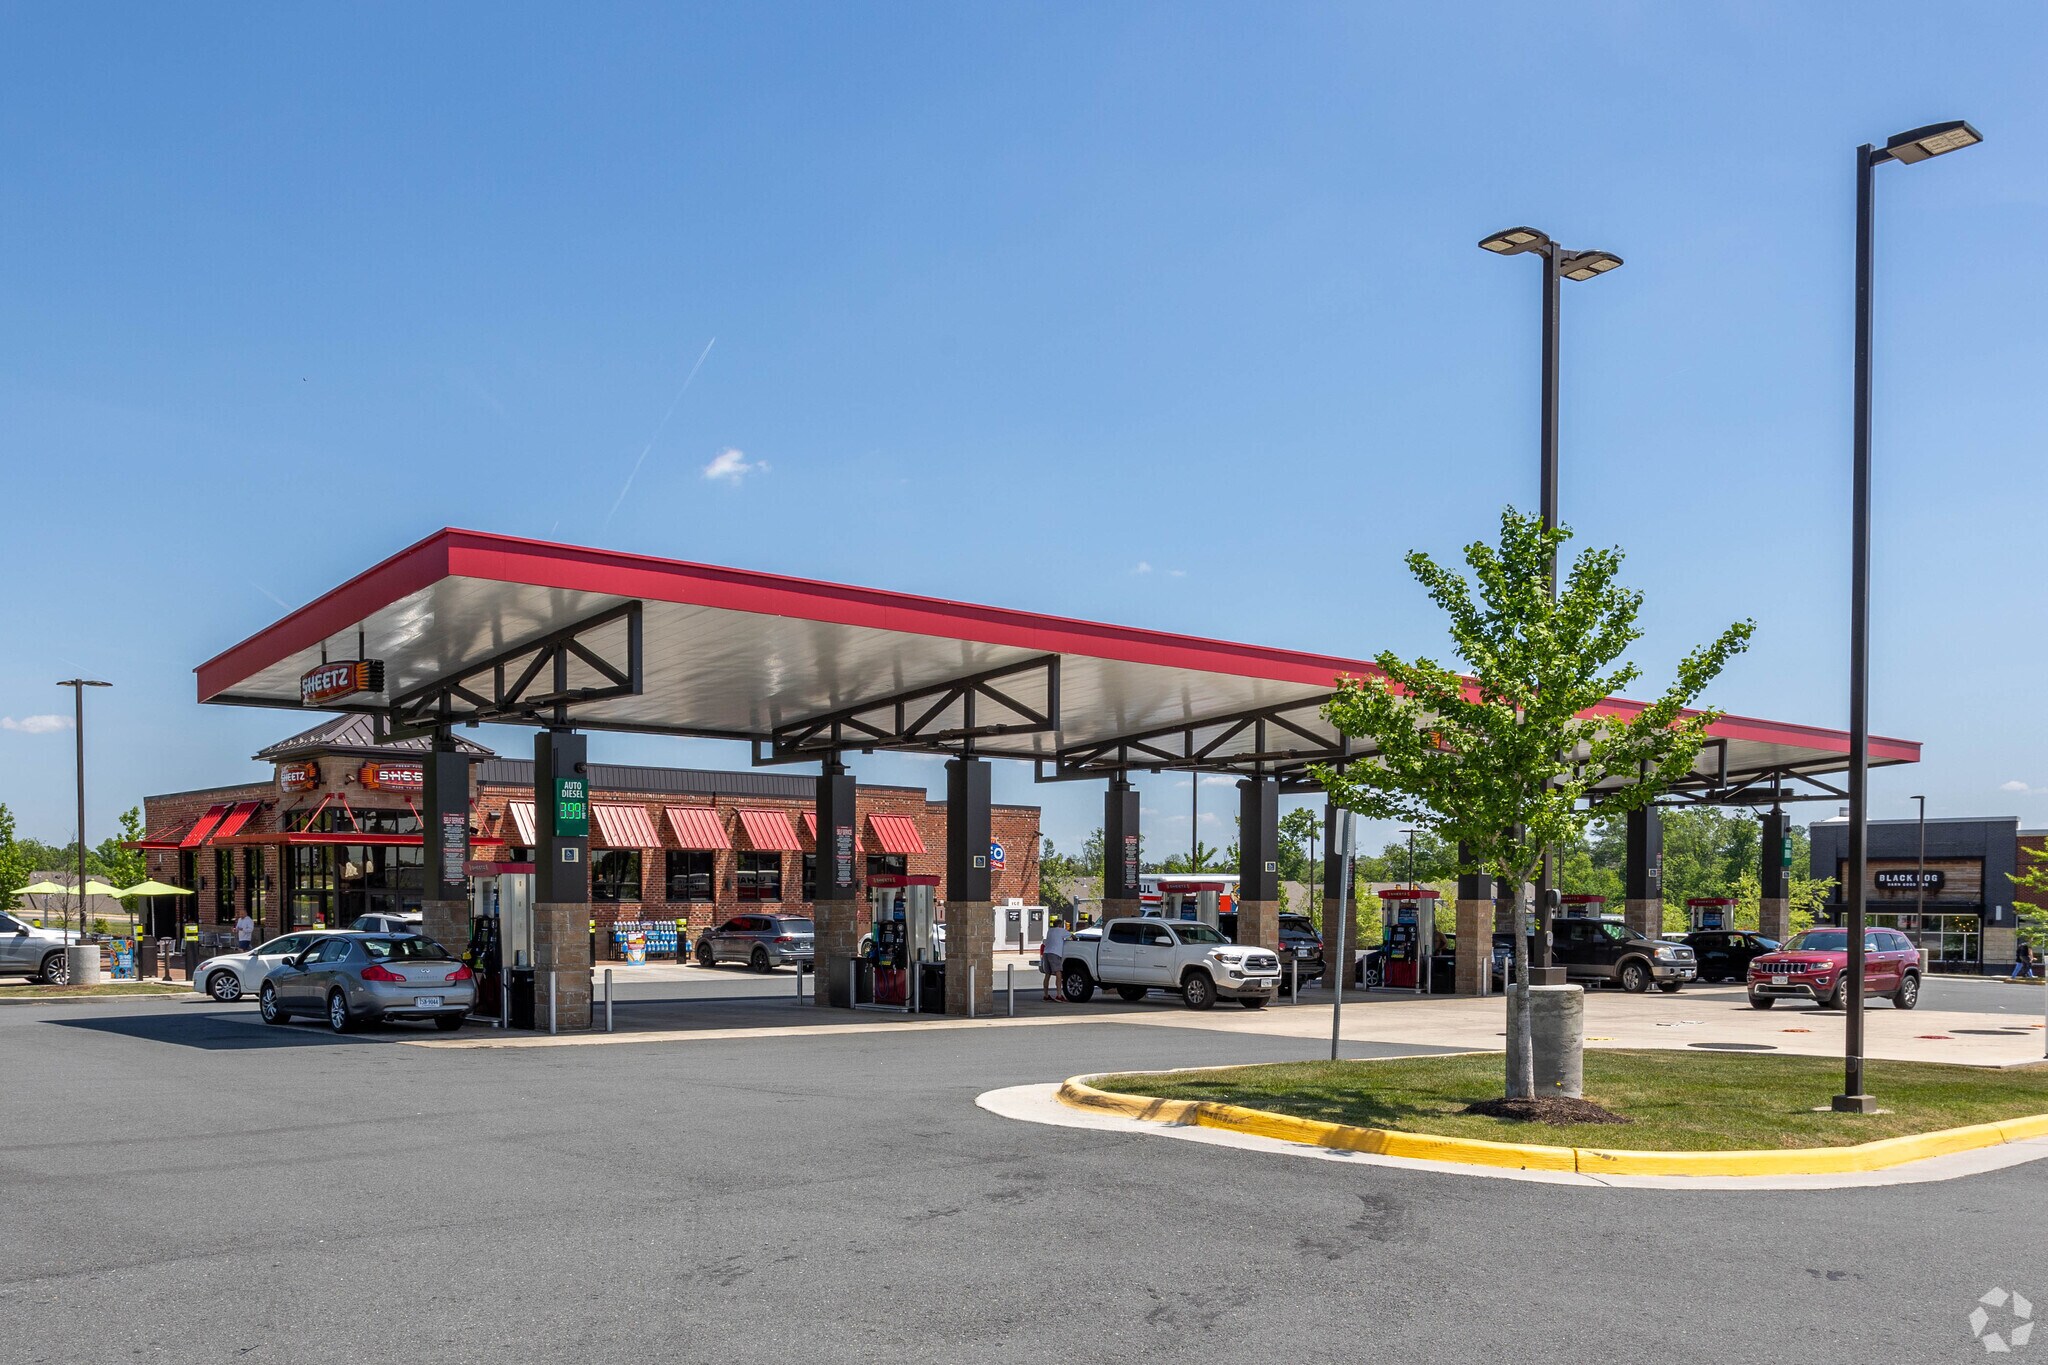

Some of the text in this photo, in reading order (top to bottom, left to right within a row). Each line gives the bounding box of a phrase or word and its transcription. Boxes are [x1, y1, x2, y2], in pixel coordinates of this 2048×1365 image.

[302, 668, 348, 694] SHEETZ
[379, 771, 423, 781] SHEE
[564, 781, 582, 790] AUTO
[561, 789, 585, 799] DIESEL
[560, 802, 581, 819] 3.99
[1879, 874, 1913, 882] BLACK
